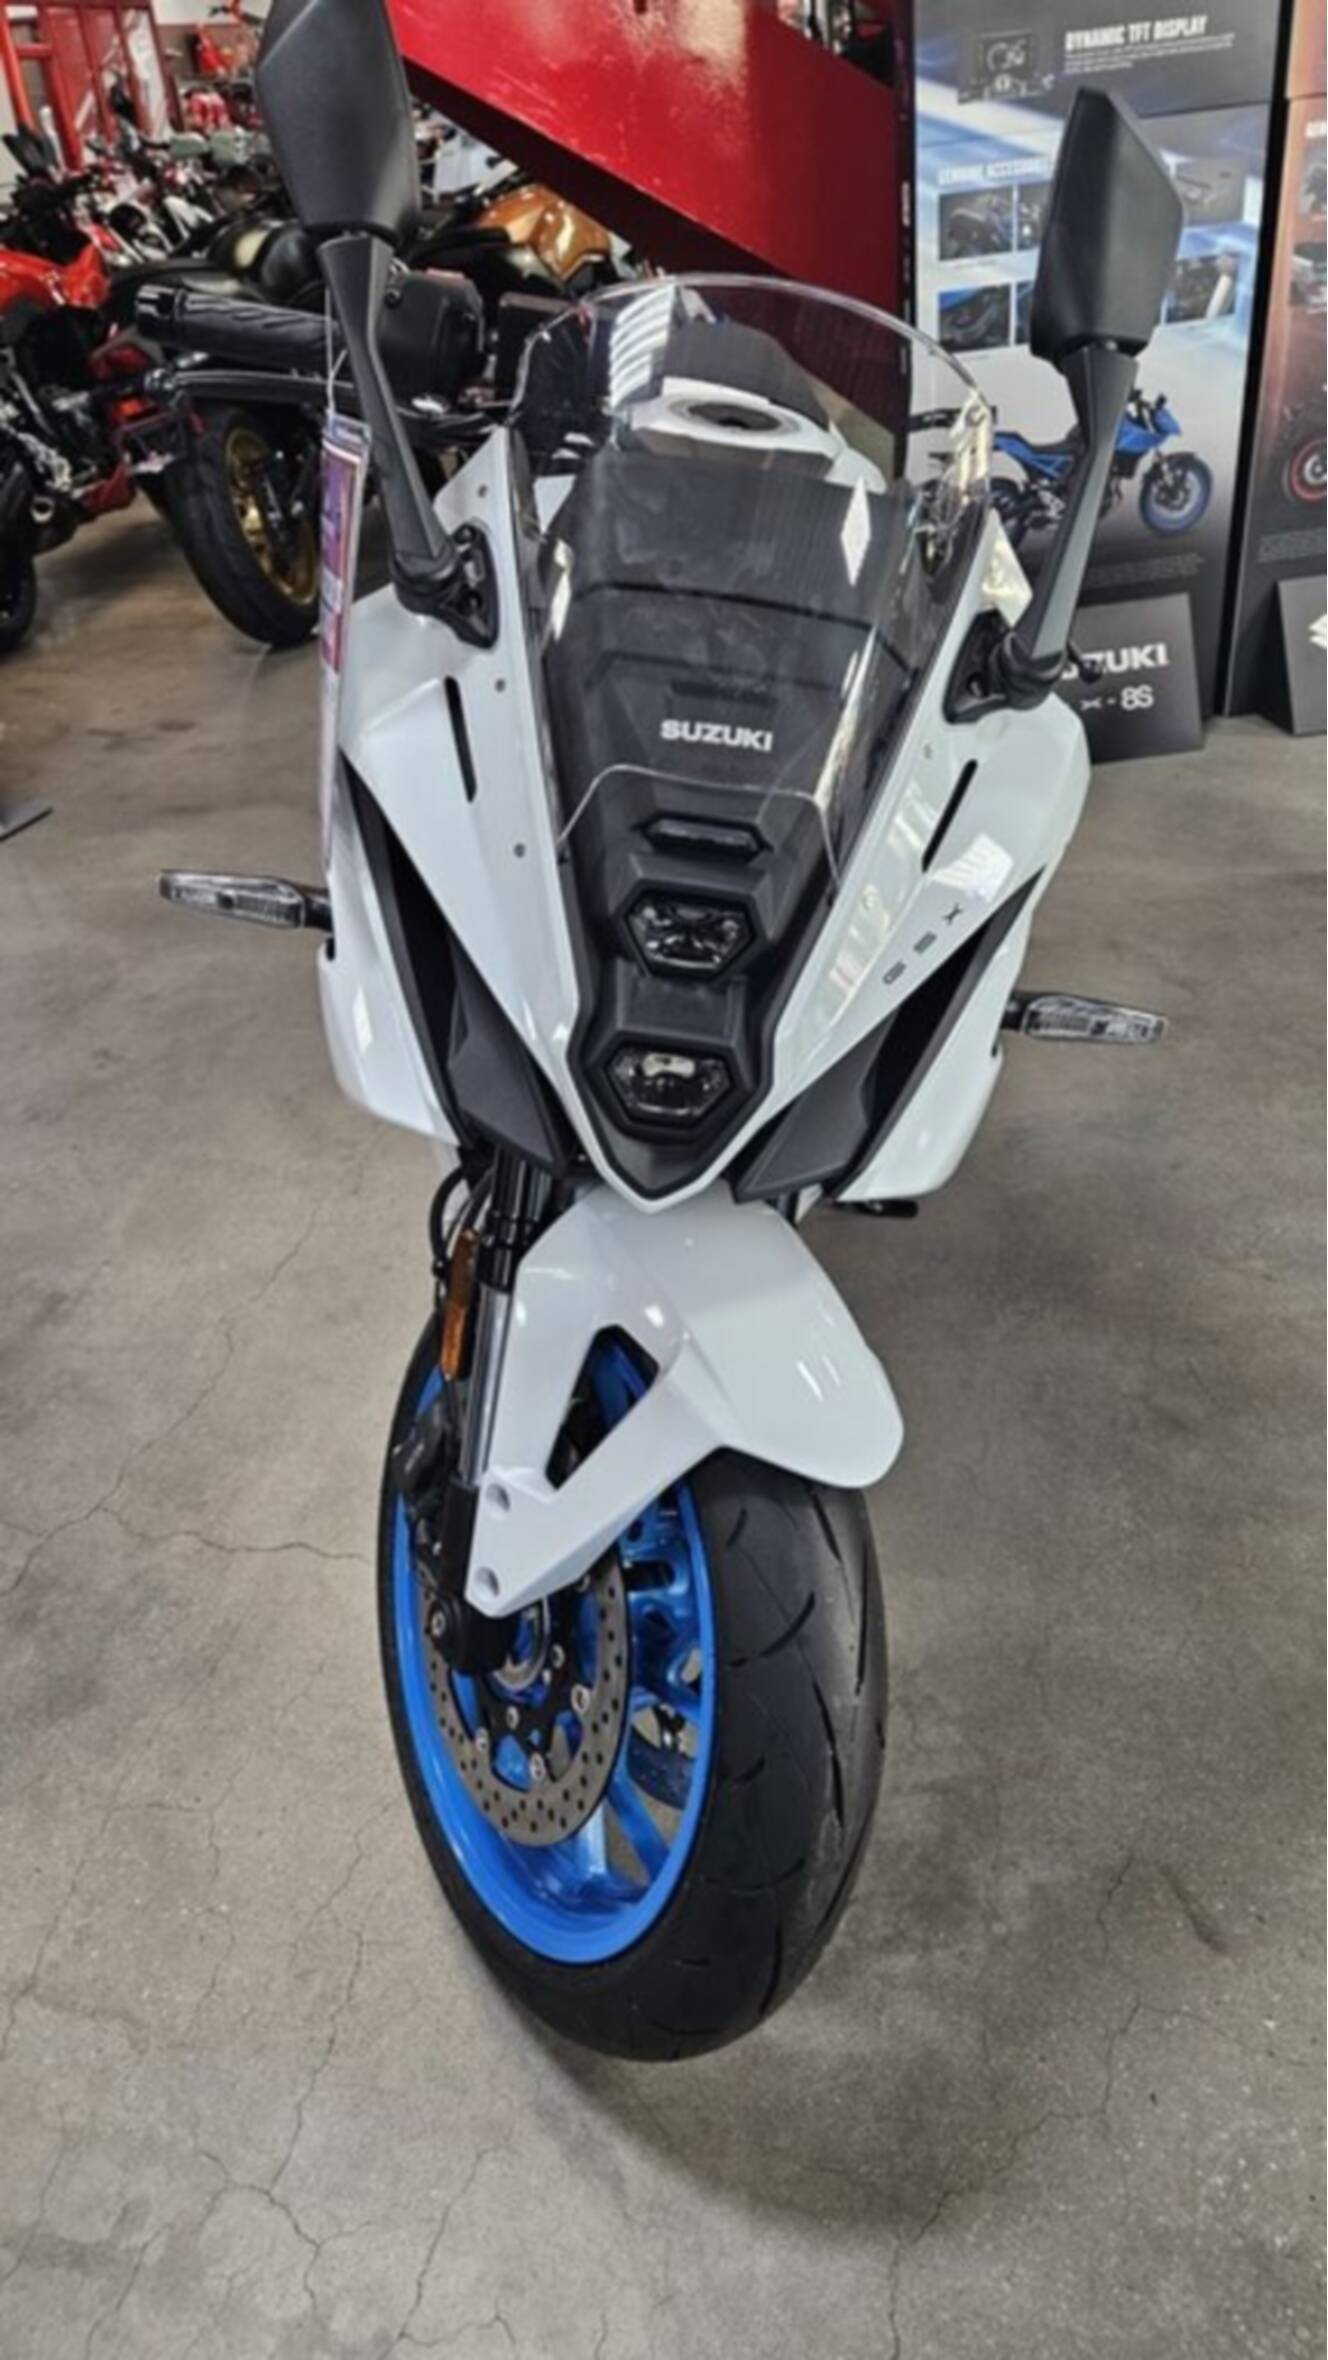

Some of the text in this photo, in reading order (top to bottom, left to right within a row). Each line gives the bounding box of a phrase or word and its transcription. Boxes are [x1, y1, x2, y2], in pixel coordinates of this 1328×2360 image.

[1128, 20, 1150, 43] TFT
[1153, 14, 1208, 41] DISPLAY
[660, 718, 773, 752] SUZUKI
